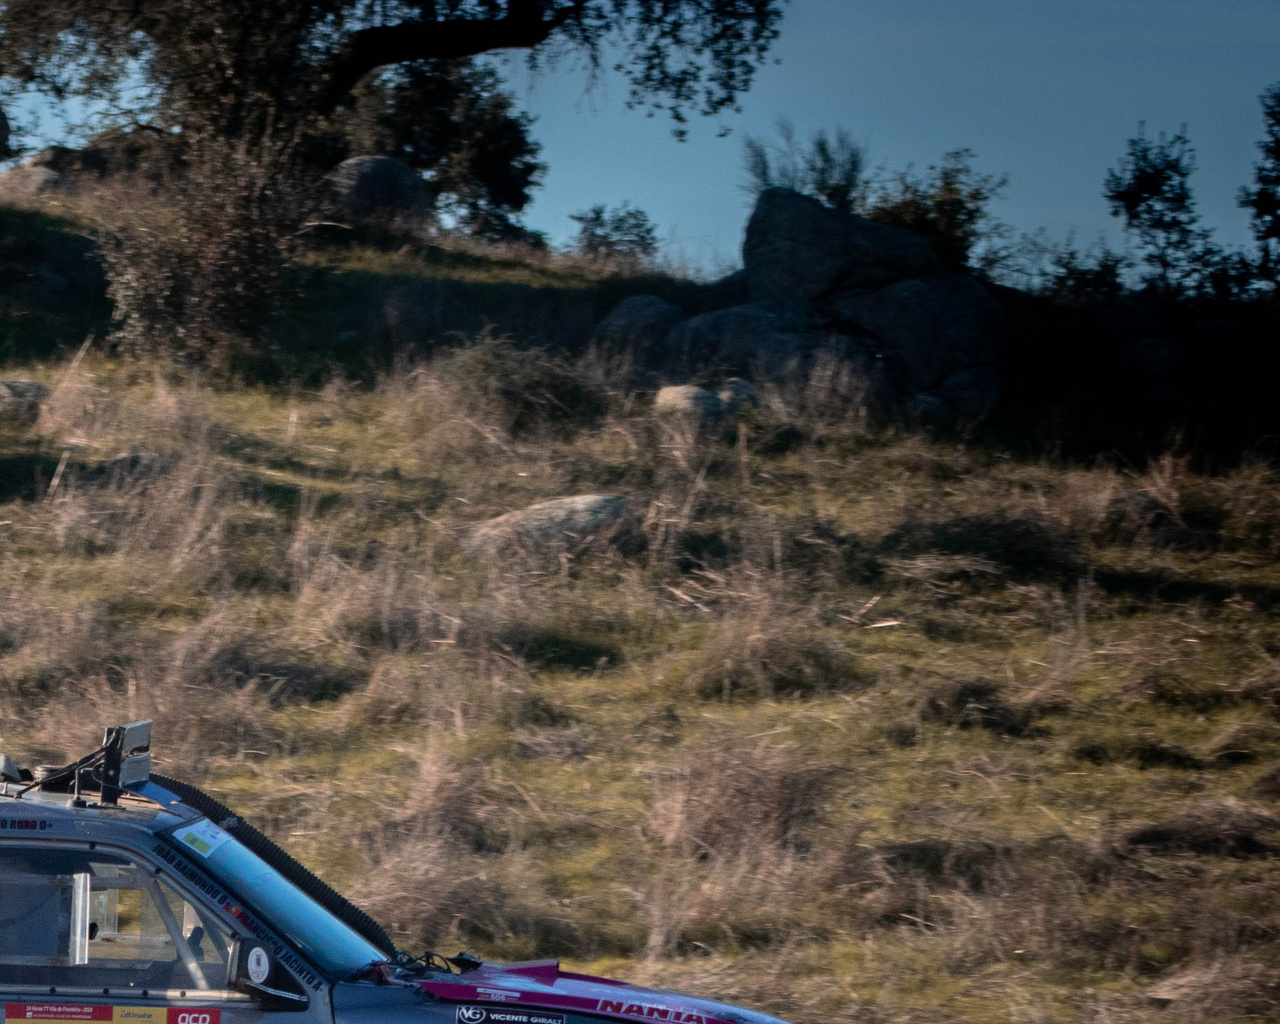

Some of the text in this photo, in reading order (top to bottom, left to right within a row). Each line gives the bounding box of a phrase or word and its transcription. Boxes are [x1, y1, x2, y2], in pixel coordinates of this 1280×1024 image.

[10, 820, 37, 830] ROXO
[173, 860, 221, 899] RAIMUNDO
[280, 951, 316, 985] JACINTO
[120, 1011, 153, 1019] ultimate
[489, 1013, 529, 1023] VICENTE
